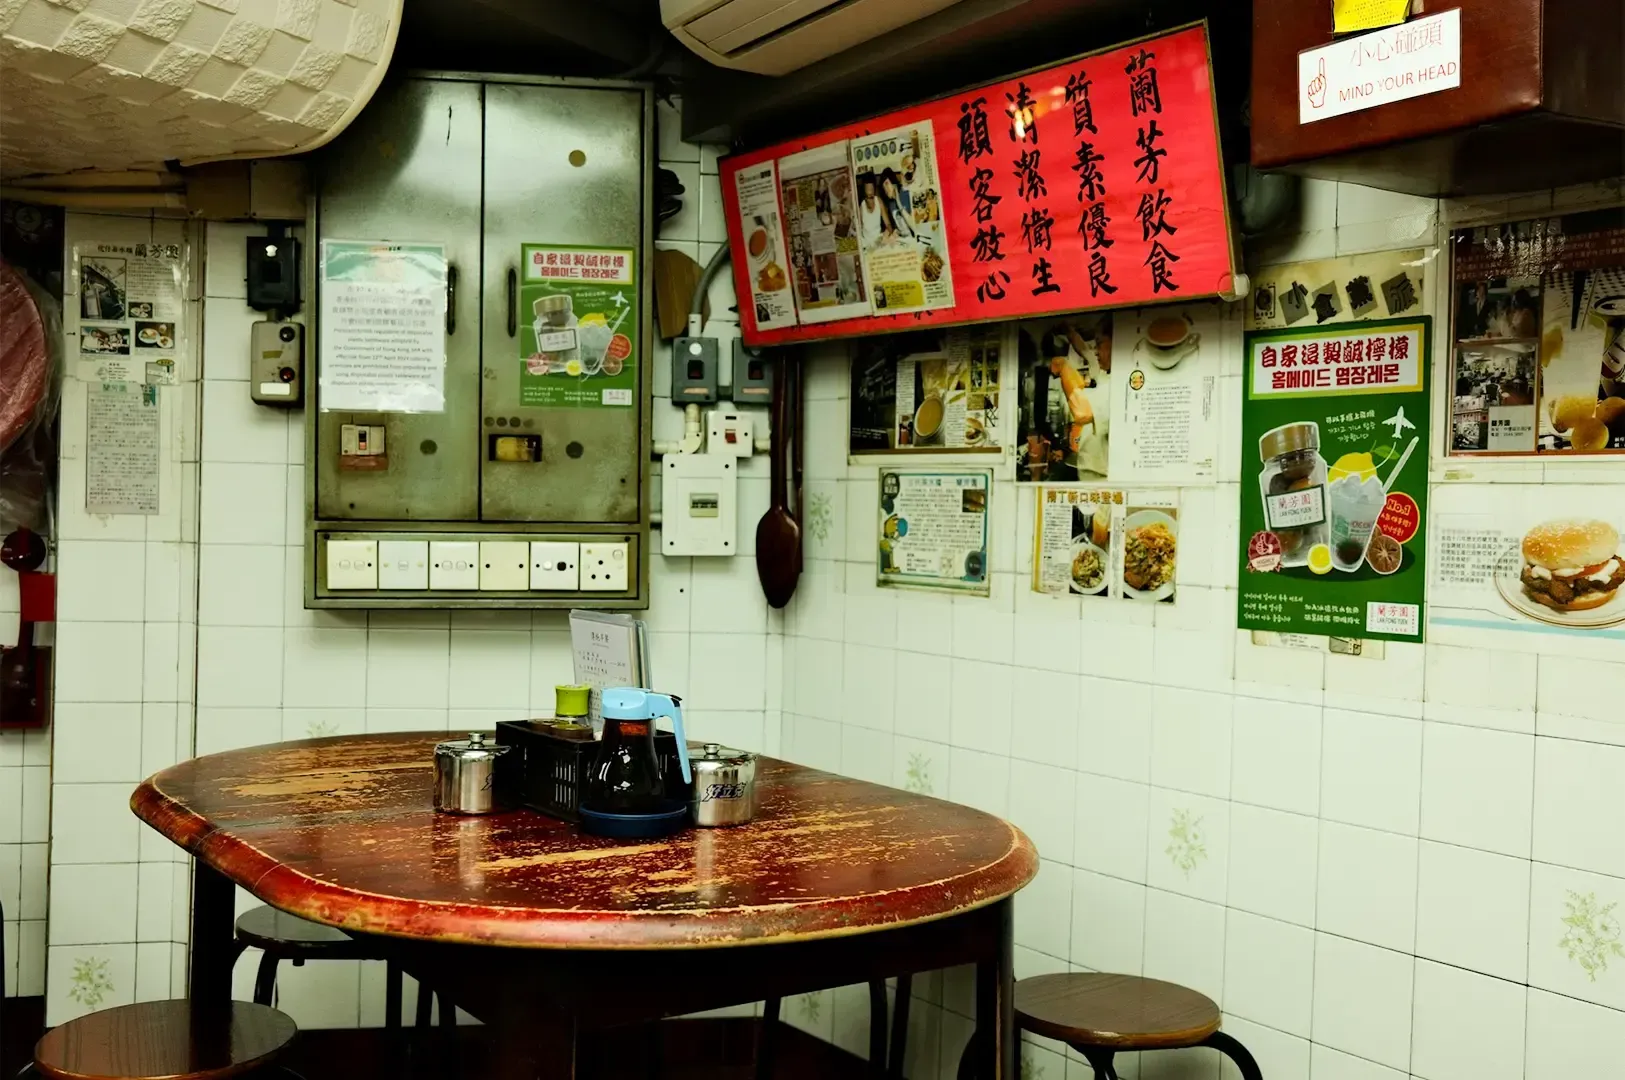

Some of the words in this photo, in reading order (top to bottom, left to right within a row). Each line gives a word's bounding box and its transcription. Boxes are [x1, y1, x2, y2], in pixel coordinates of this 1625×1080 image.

[1350, 20, 1443, 67] 小心碰頭
[1339, 82, 1374, 102] MIND
[1377, 72, 1414, 92] YOUR
[1418, 61, 1457, 83] HEAD
[1005, 81, 1061, 297] 清潔衛生
[1064, 70, 1118, 298] 質素優良
[1124, 49, 1180, 294] 蘭芳飲食
[957, 97, 1011, 304] 顧客放心
[1261, 335, 1410, 369] 自家浸製鹹檸檬
[1271, 369, 1331, 389] 홈메이드
[1335, 363, 1400, 385] 염장레몬
[1278, 493, 1311, 510] 蘭芳園
[1386, 498, 1411, 516] No.1
[1377, 604, 1409, 618] 蘭芳園
[702, 782, 747, 803] 好立克
